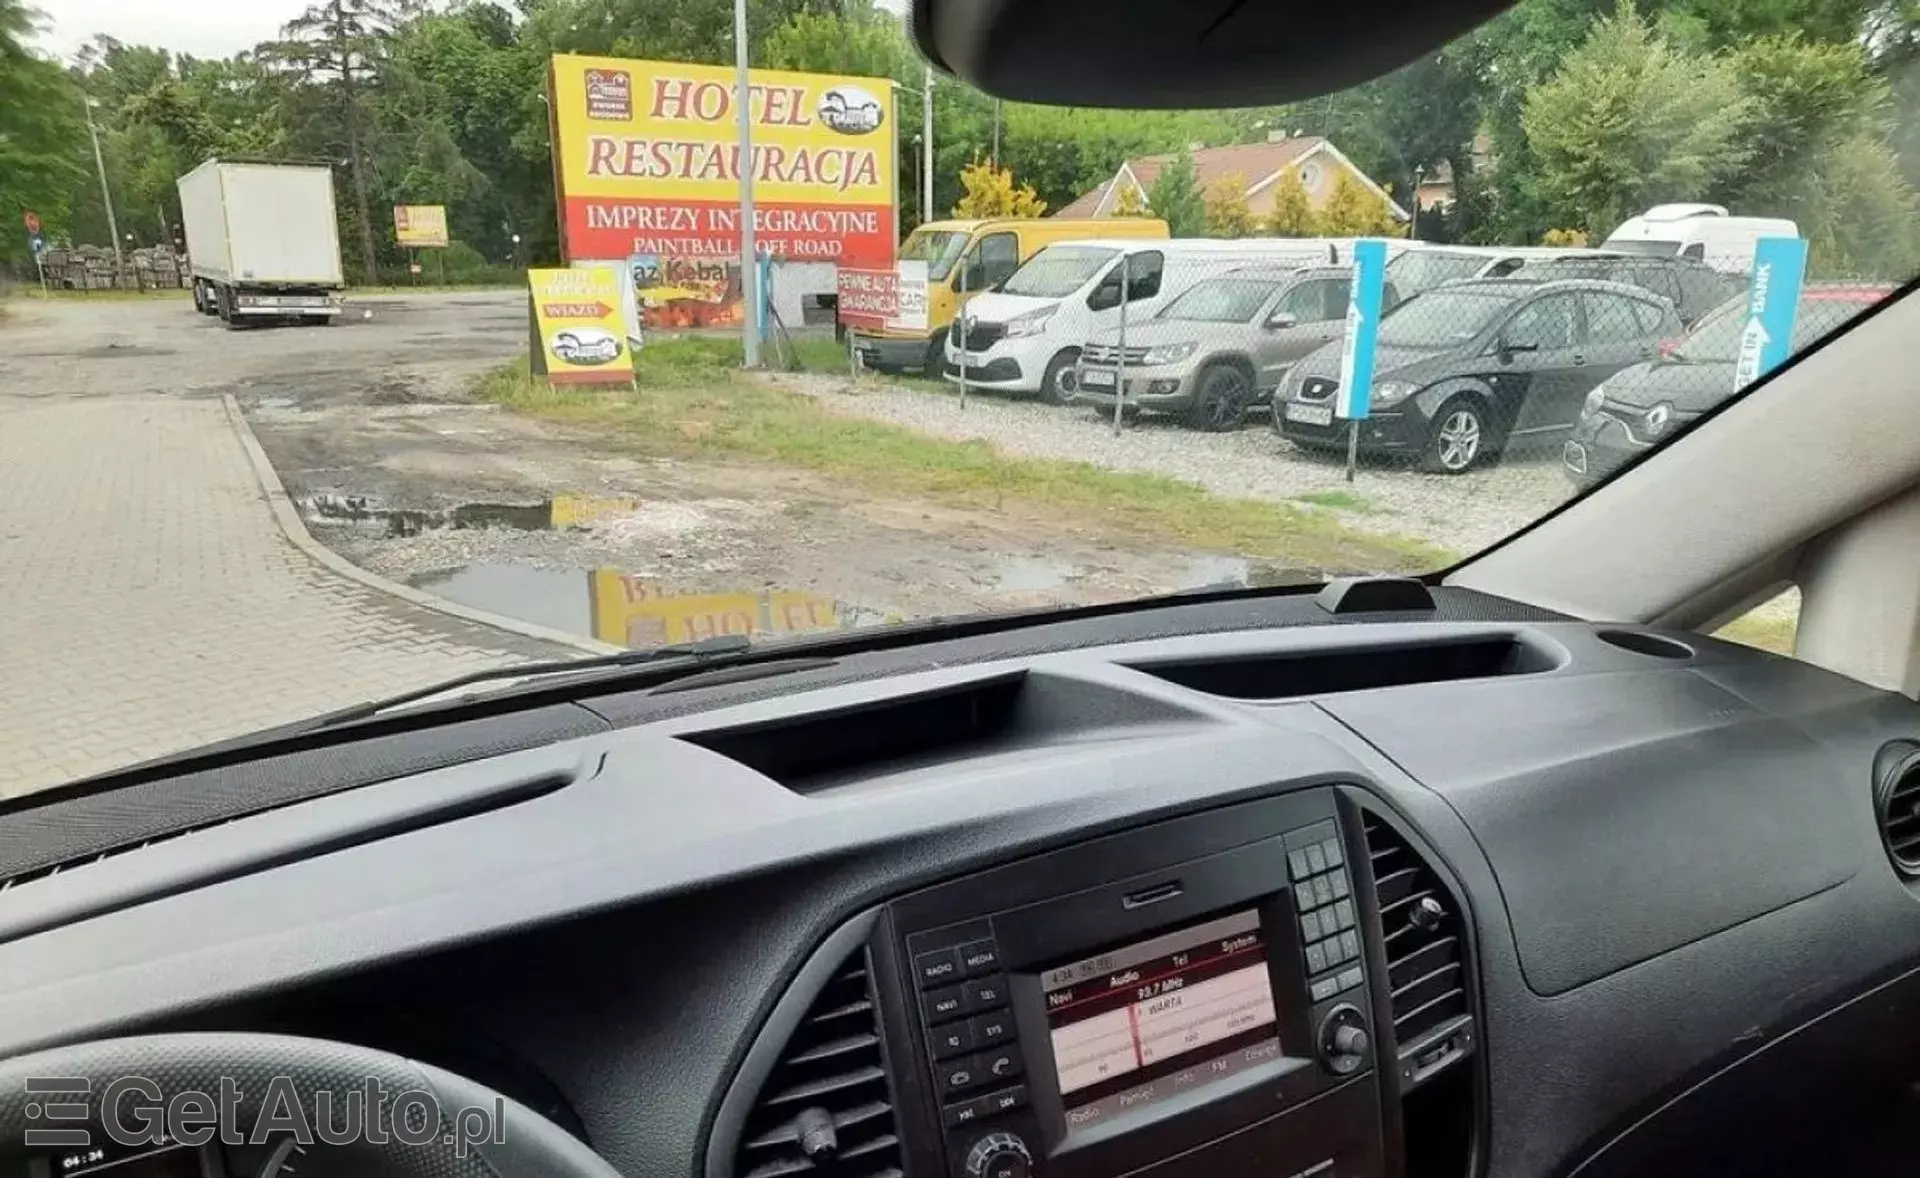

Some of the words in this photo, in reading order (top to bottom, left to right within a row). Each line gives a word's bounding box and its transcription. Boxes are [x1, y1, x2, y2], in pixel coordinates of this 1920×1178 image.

[587, 138, 878, 192] RESTAURACJA
[586, 204, 702, 231] IMPREZY
[633, 237, 734, 254] PAINTBALL
[755, 239, 788, 255] OFF
[793, 239, 843, 256] ROAD
[1751, 262, 1771, 313] BANK
[926, 963, 952, 976] RADIO
[968, 952, 994, 966] MEDIA
[1049, 988, 1073, 1006] Navi
[1110, 971, 1140, 987] Audio
[1173, 953, 1189, 967] Tel
[1222, 935, 1257, 954] System
[1070, 1108, 1100, 1125] Radio
